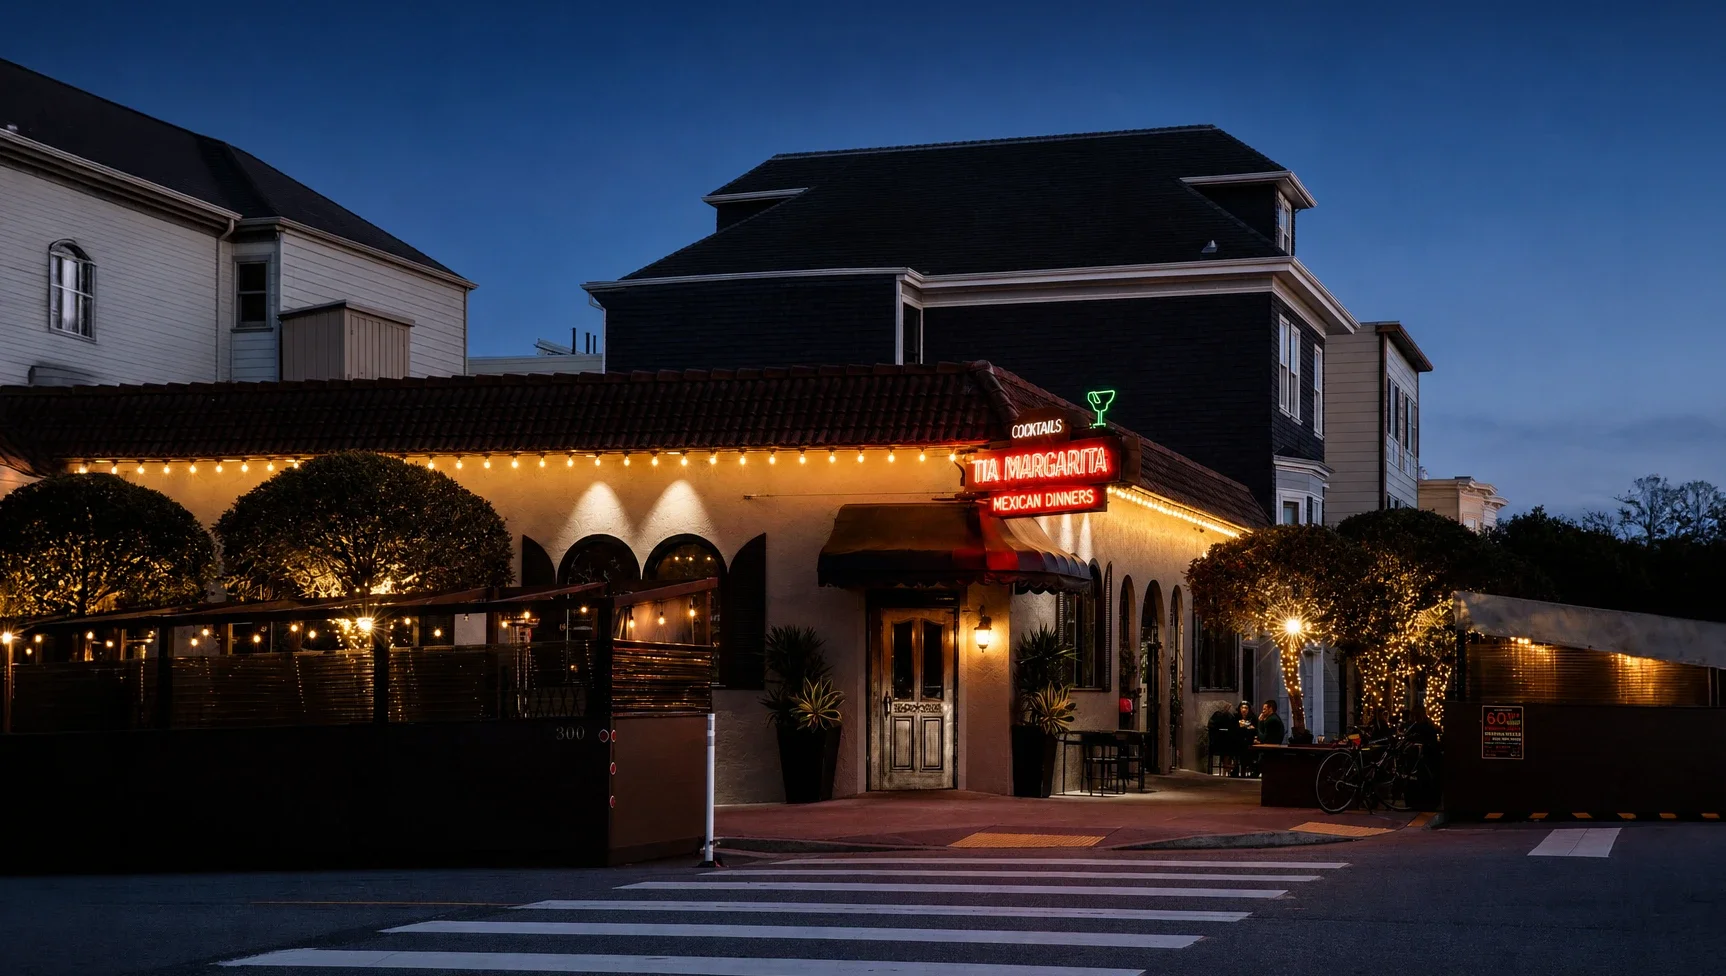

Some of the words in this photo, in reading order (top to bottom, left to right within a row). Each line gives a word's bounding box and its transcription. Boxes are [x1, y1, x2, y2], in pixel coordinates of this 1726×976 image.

[1011, 418, 1063, 439] COCKTAILS
[971, 457, 999, 484] TIA
[1004, 446, 1108, 481] MARGARITA
[993, 494, 1042, 512] MEXICAN
[1045, 489, 1094, 508] DINNERS
[556, 726, 585, 740] 300
